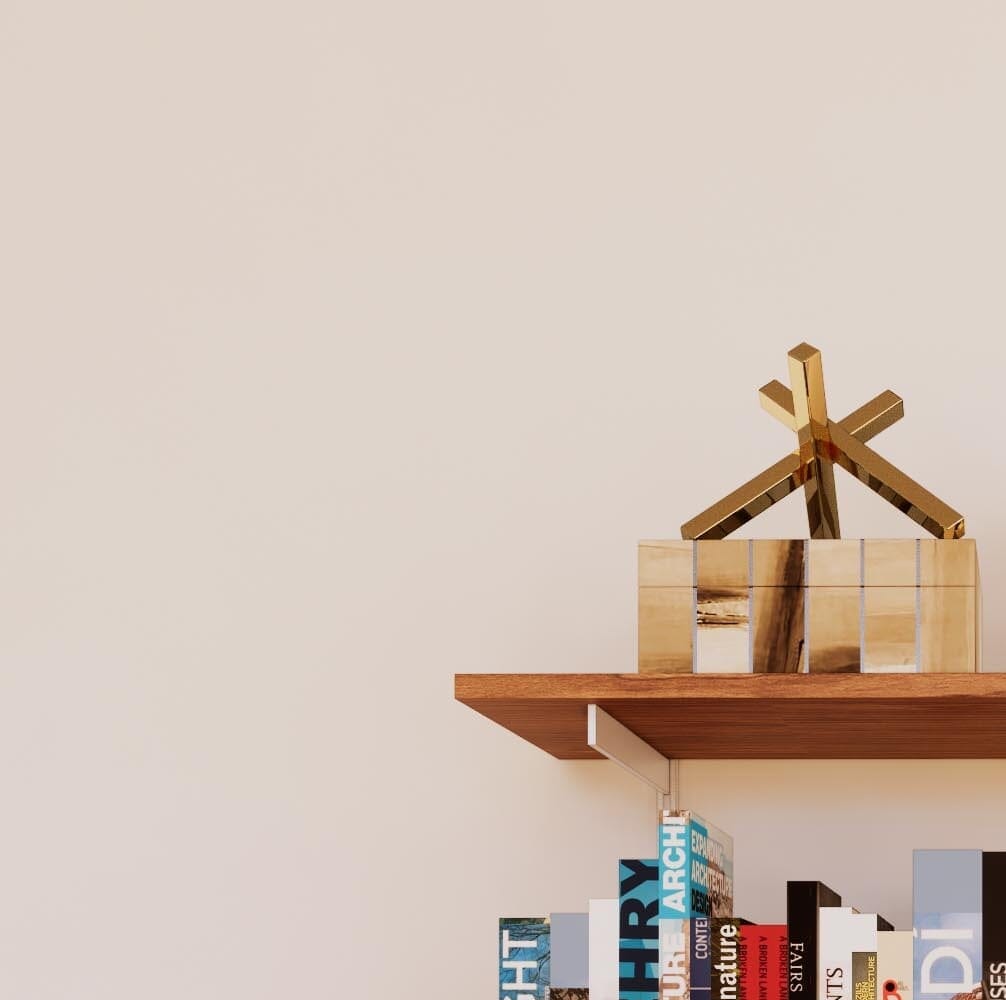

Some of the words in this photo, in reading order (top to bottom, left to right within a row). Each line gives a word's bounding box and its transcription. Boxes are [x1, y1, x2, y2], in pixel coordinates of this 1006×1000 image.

[695, 917, 708, 959] CONTE
[758, 944, 767, 979] BROKEN
[779, 944, 787, 979] BROKEN
[790, 942, 804, 992] FAIRS
